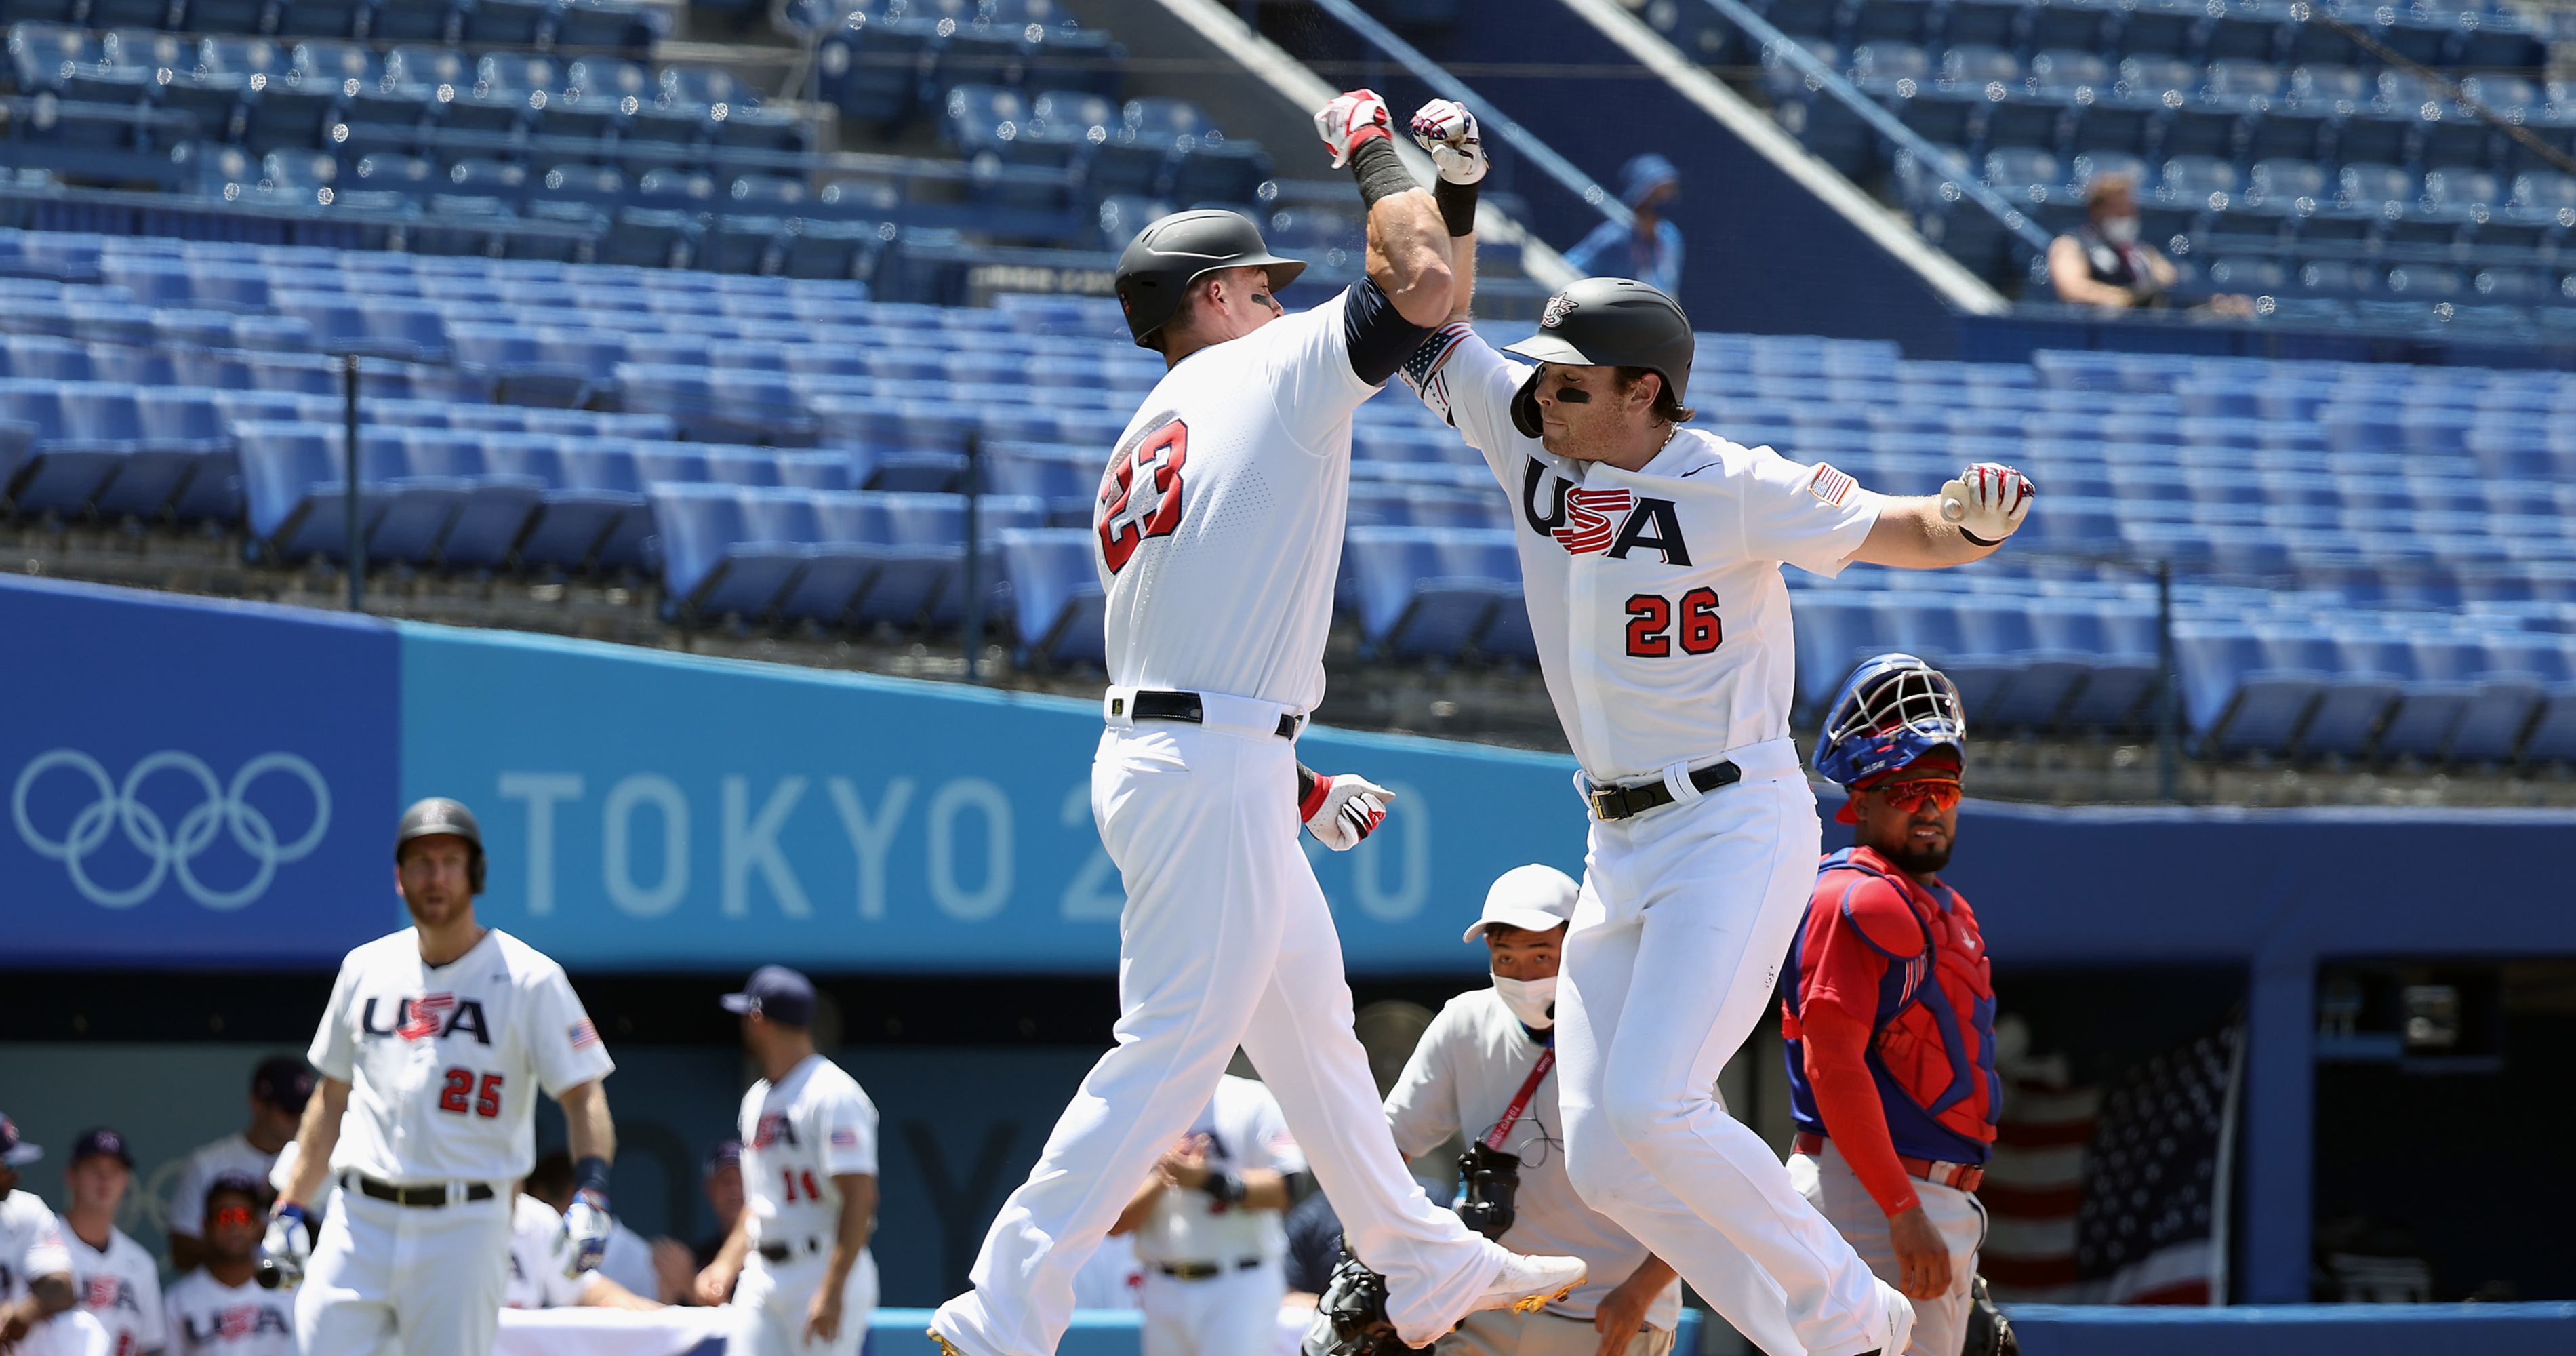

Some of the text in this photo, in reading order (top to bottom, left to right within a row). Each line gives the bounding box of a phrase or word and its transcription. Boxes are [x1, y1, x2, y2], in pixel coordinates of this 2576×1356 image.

[1098, 418, 1188, 575] 23
[1523, 453, 1693, 567] USA
[1625, 586, 1723, 658] 26
[498, 772, 1016, 921] TOKYO
[362, 991, 492, 1046] USA
[438, 1066, 504, 1119] 25
[182, 1302, 291, 1344] USA
